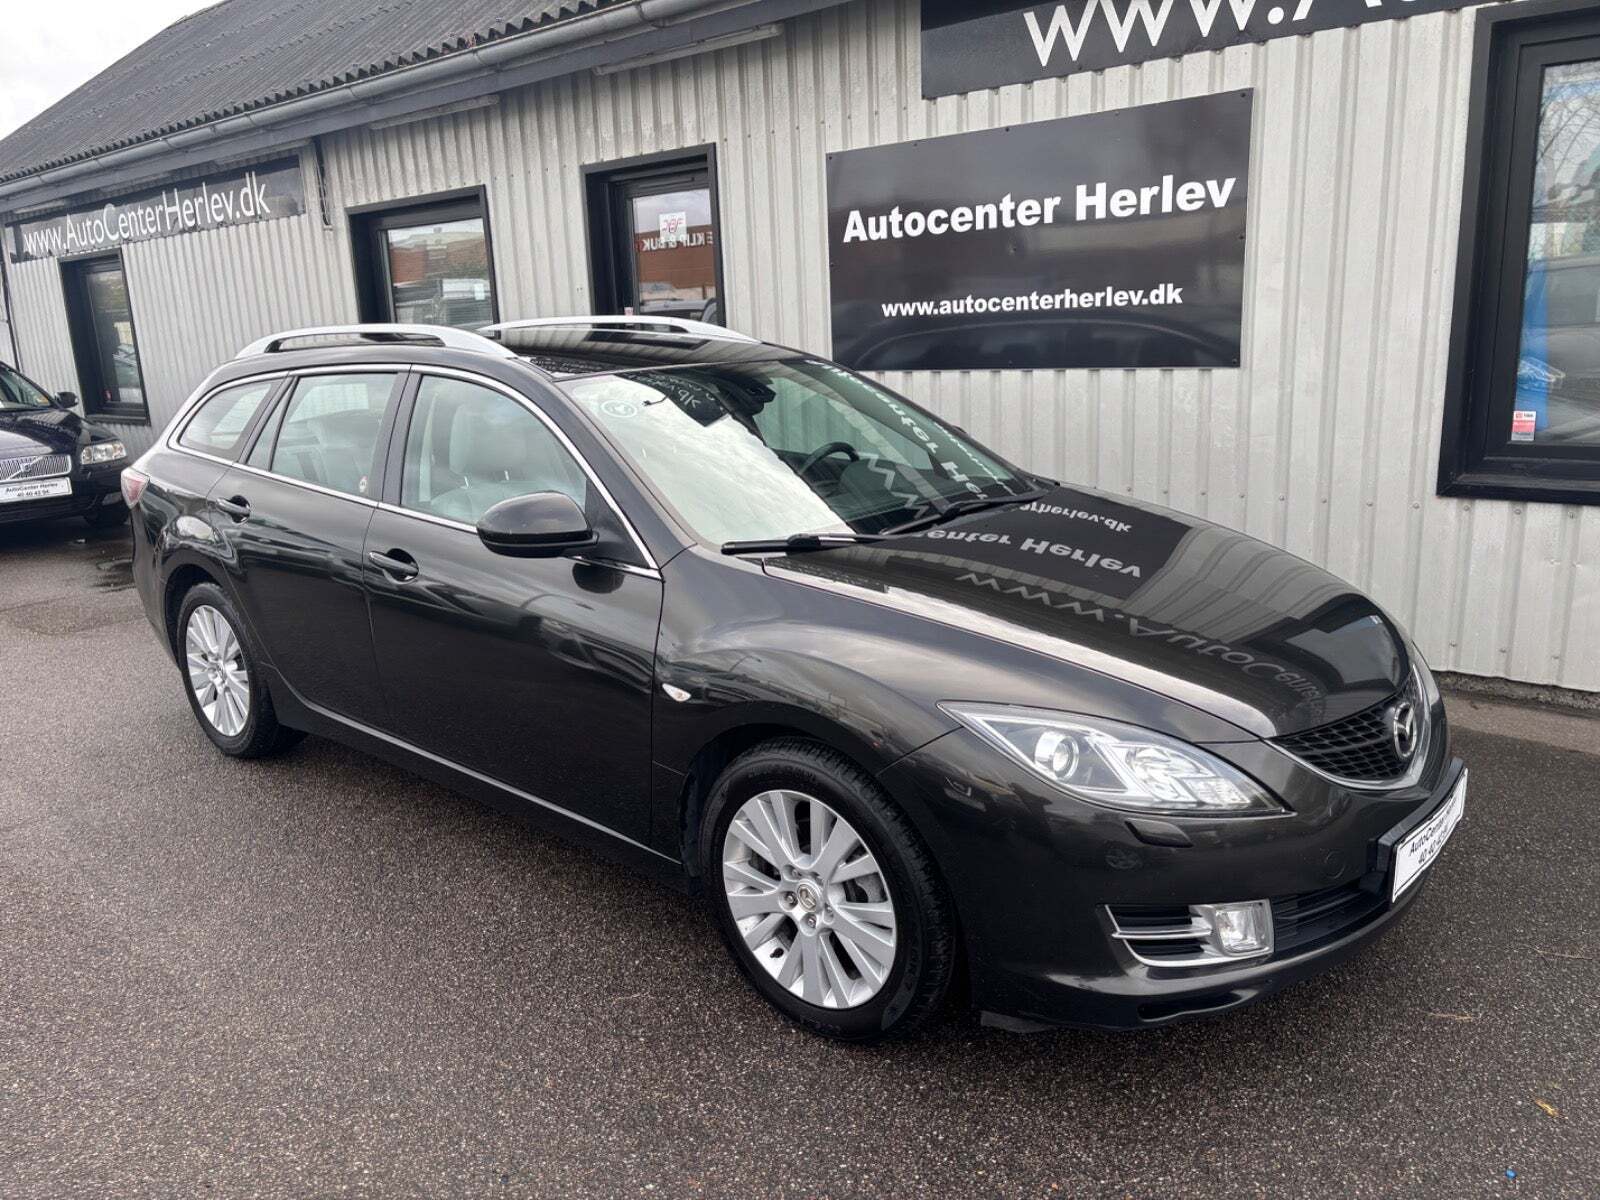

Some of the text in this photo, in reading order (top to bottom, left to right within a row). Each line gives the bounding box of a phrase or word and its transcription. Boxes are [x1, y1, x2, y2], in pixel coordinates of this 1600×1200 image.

[1024, 0, 1416, 66] www.
[24, 171, 270, 255] www.AutoCenterHerlev.dk
[842, 174, 1237, 243] Autocenter Herlev
[881, 283, 1184, 317] www.autocenterherlev.dk
